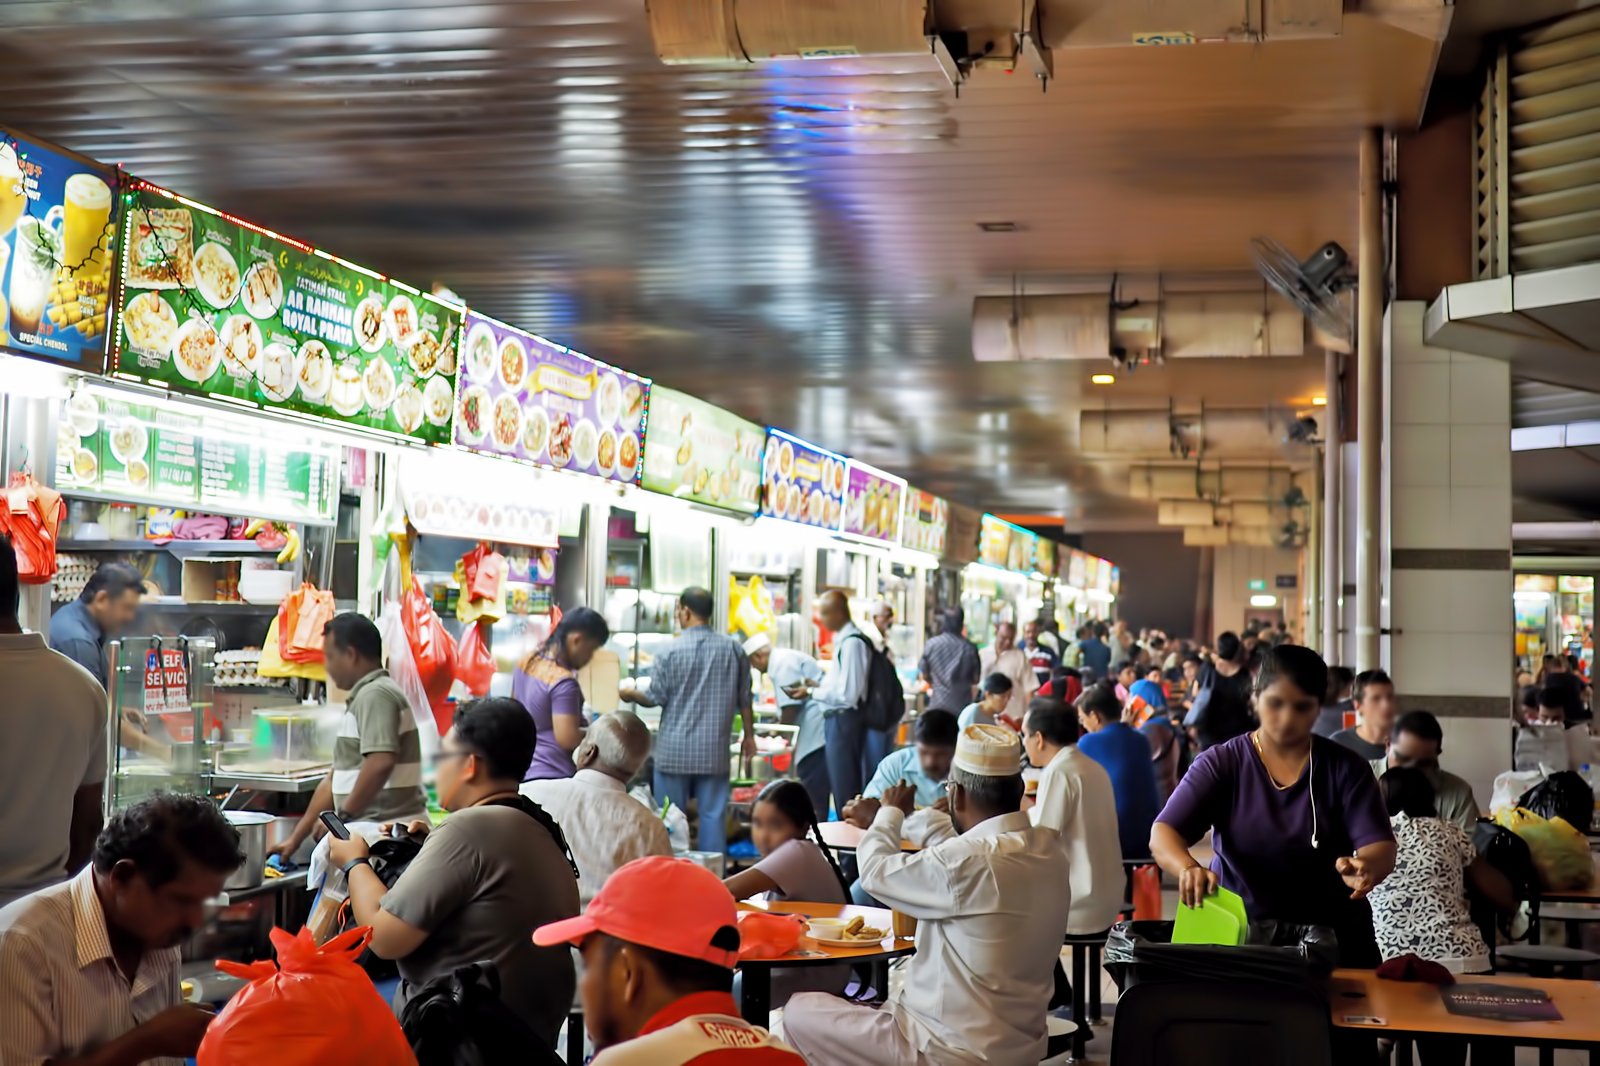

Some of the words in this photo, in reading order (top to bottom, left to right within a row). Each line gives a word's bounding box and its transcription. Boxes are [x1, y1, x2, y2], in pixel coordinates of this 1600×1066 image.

[327, 286, 346, 304] STALL
[287, 289, 303, 310] AR
[306, 295, 353, 328] RAHMAN
[283, 308, 317, 336] ROYAL
[319, 319, 353, 347] PRATA
[19, 332, 42, 346] SPECIAL
[43, 338, 68, 352] CHENDOL
[157, 654, 181, 668] ELF
